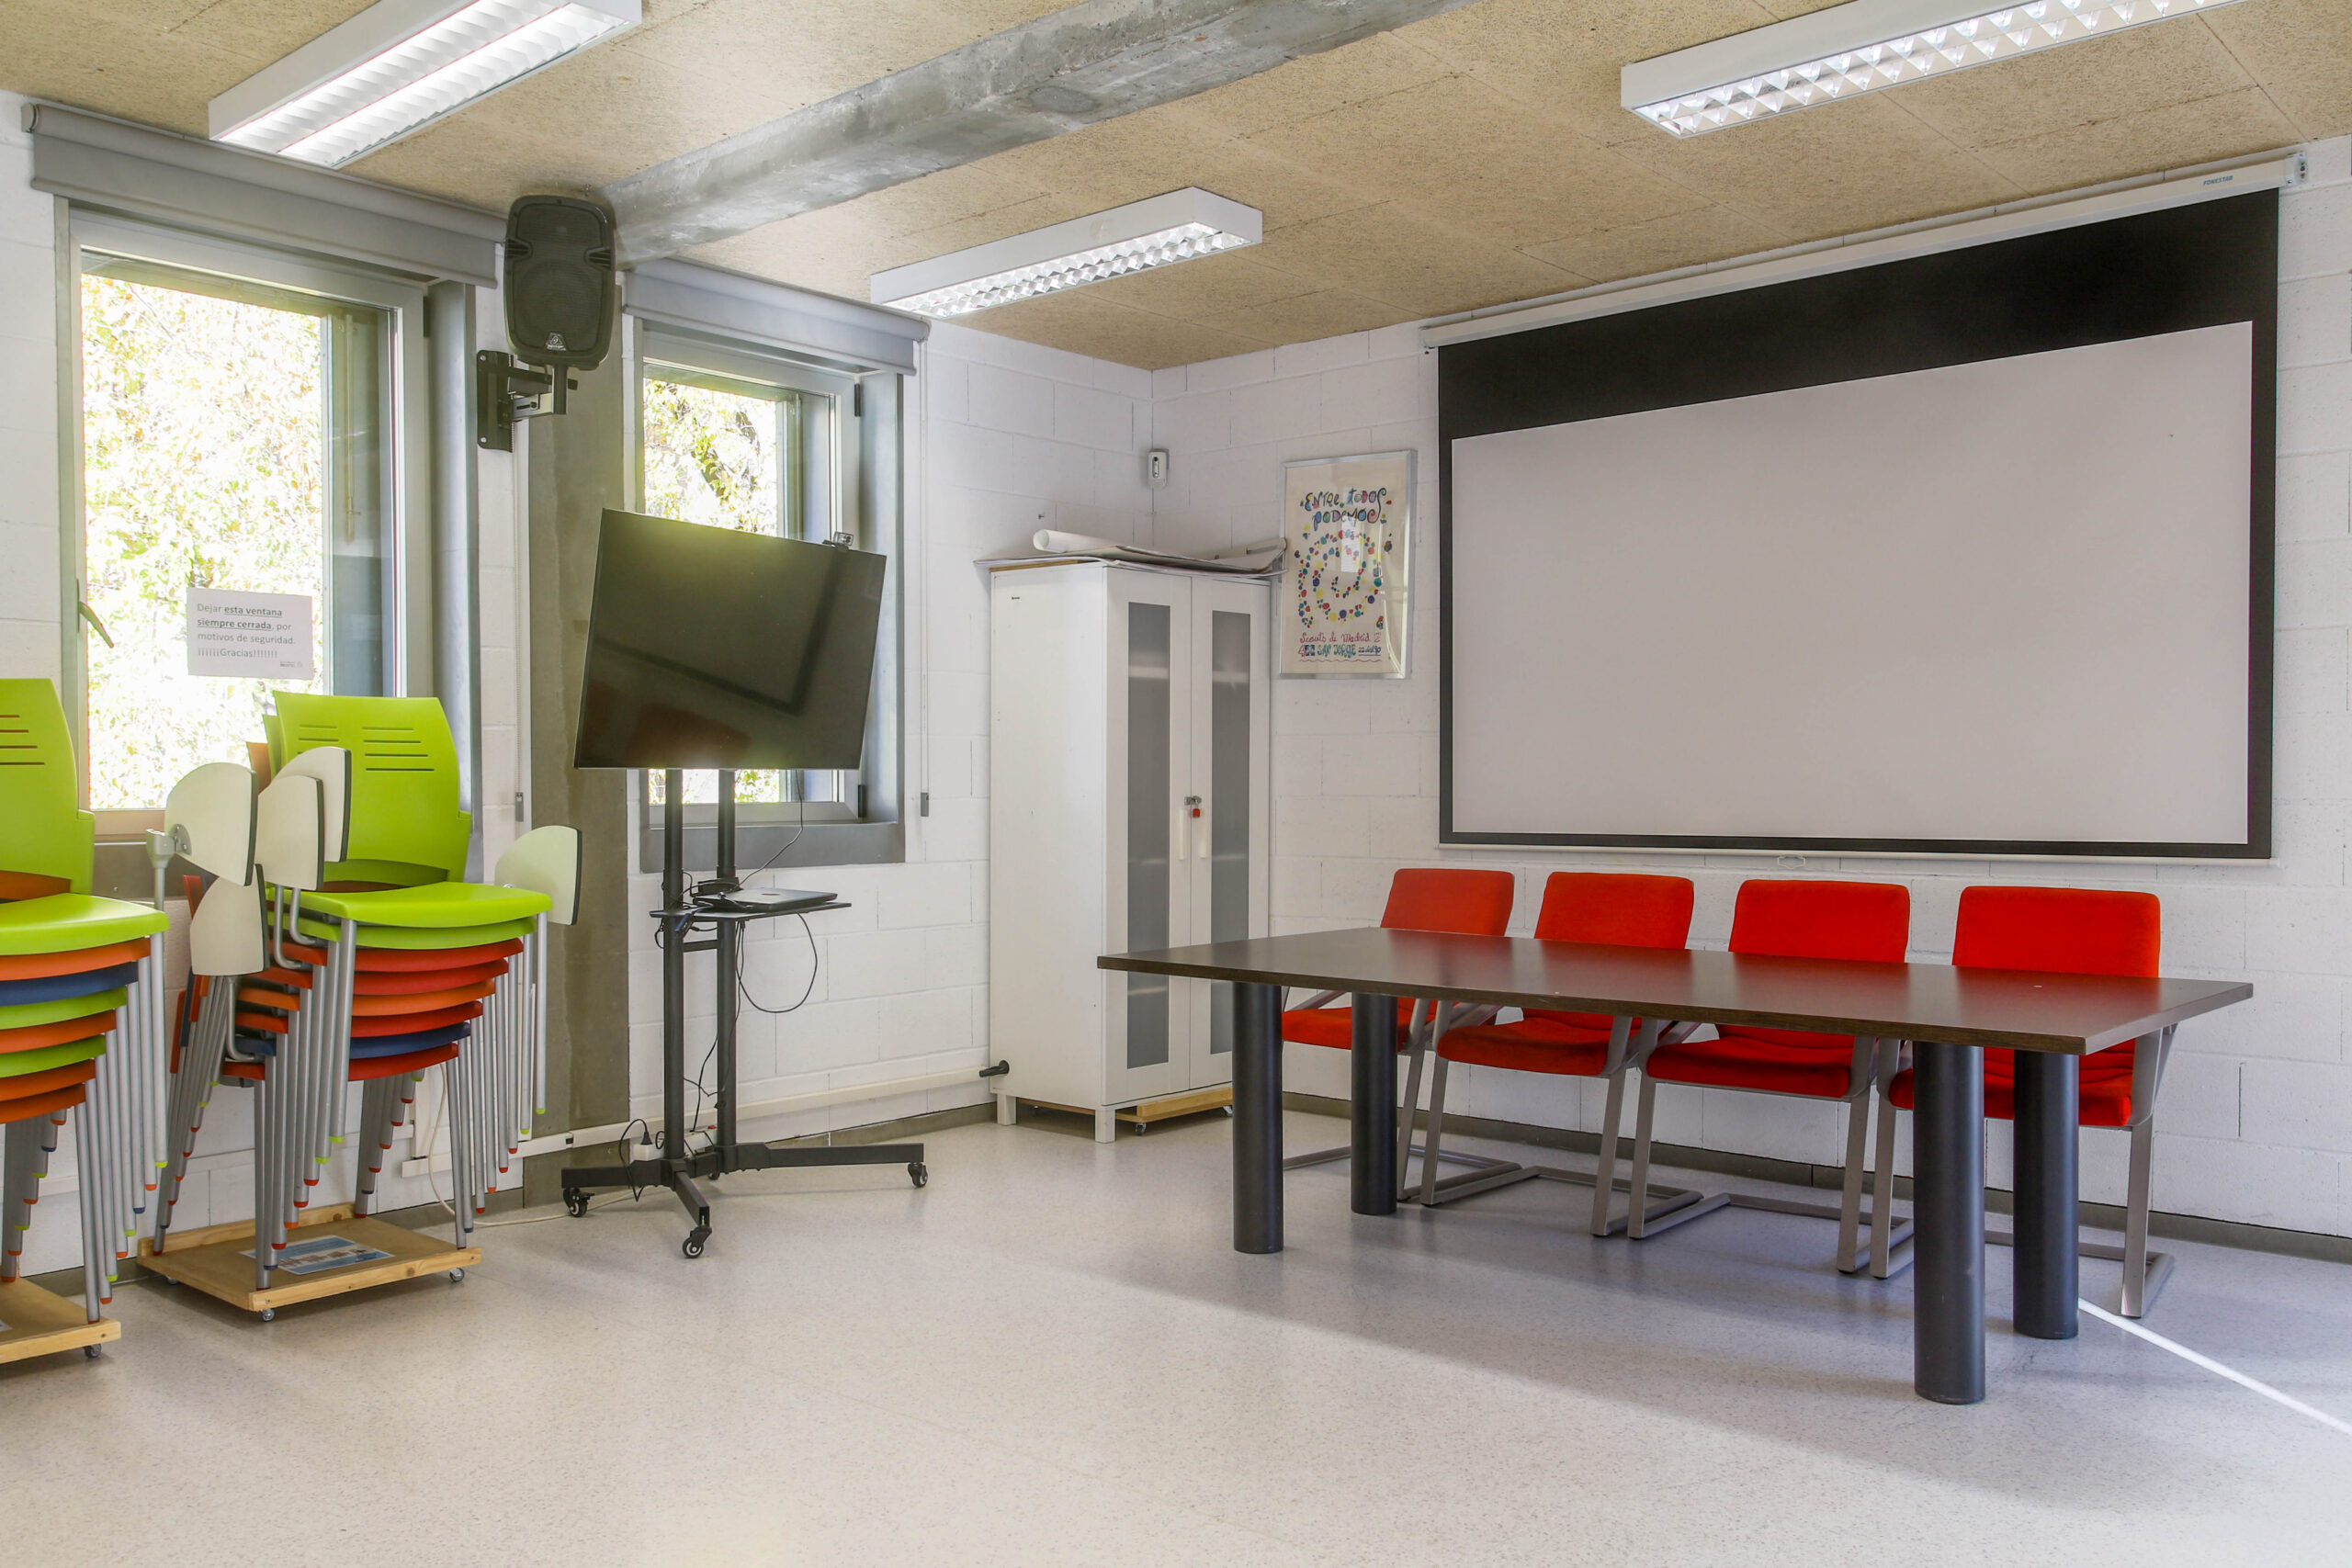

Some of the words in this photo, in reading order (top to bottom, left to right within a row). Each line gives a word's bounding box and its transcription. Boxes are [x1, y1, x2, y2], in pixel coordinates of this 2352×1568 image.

[2203, 175, 2233, 186] FONESTAR
[197, 604, 221, 614] Dejar
[224, 605, 243, 615] esta
[245, 606, 282, 616] ventana
[198, 618, 235, 627] siempre
[237, 620, 274, 631] cerrada,
[198, 632, 234, 642] motivos
[236, 634, 248, 642] de
[250, 635, 296, 645] seguridad.
[1299, 631, 1327, 643] Scouts
[1329, 631, 1337, 642] de
[1341, 632, 1370, 643] Madrid
